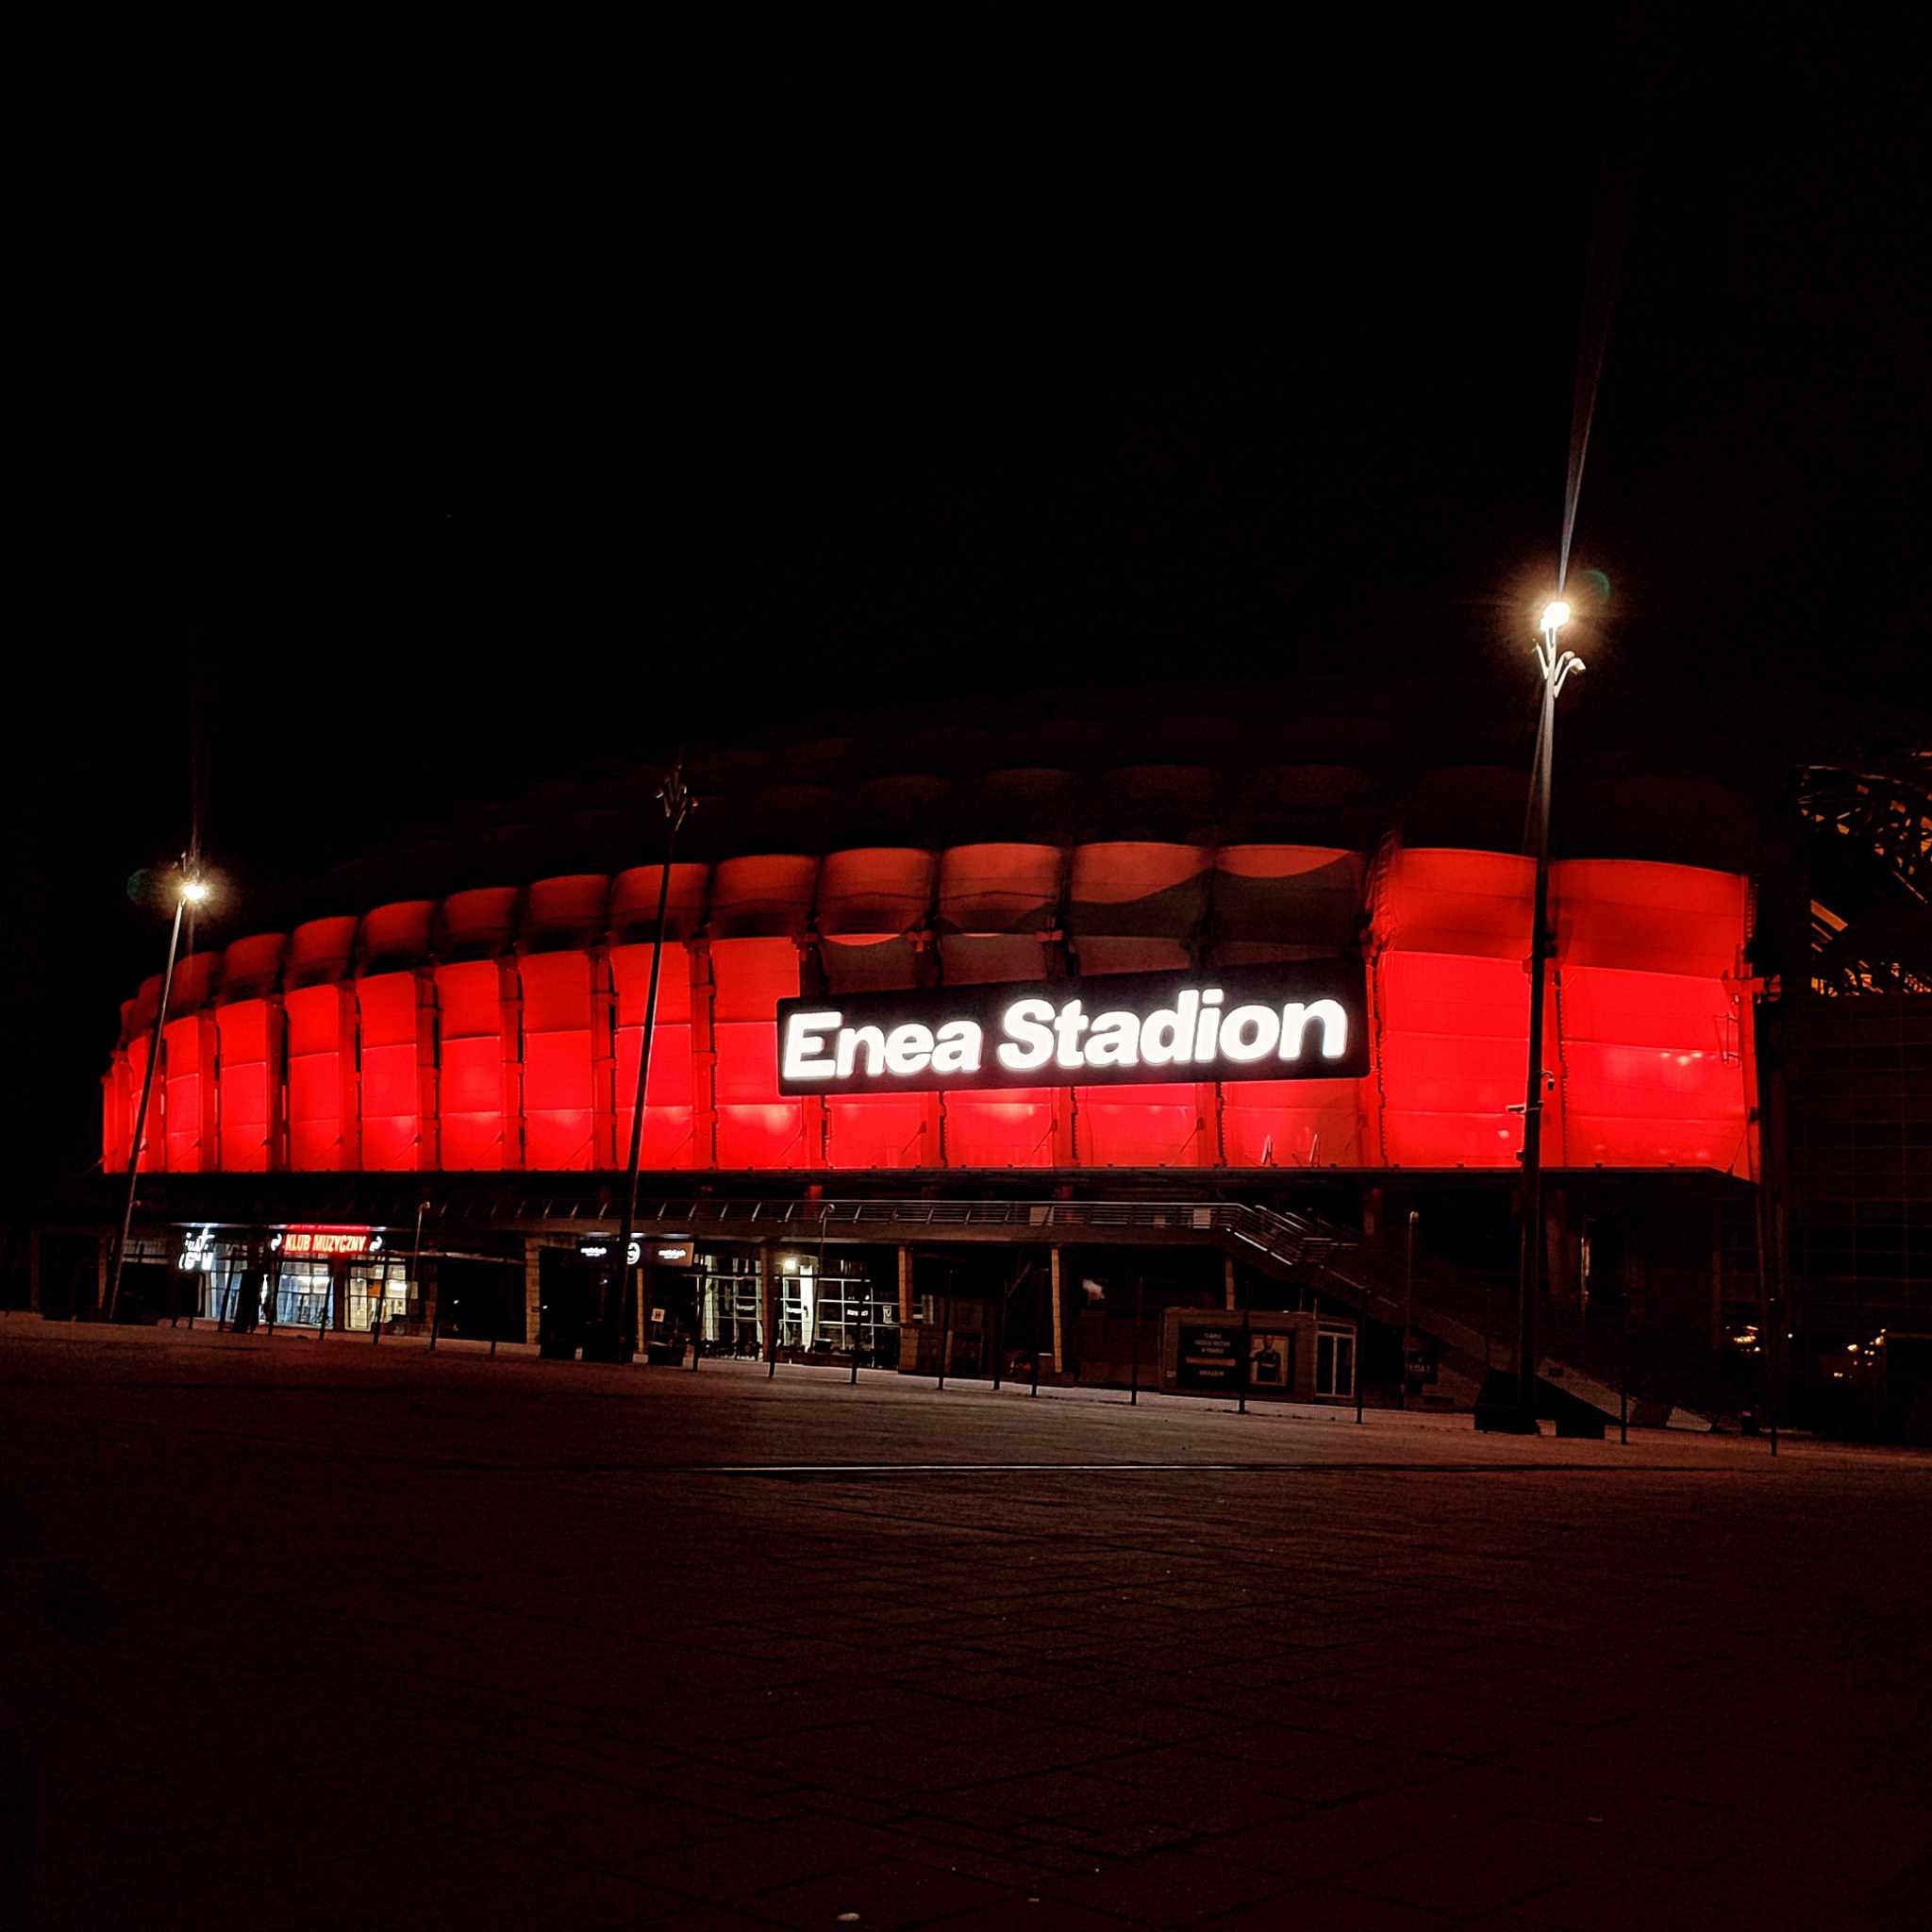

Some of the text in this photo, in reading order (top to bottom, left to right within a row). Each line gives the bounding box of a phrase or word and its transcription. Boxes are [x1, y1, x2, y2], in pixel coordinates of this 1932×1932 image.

[783, 988, 1348, 1080] Enea Stadion
[285, 1234, 366, 1253] KLUB MUZYCZNY
